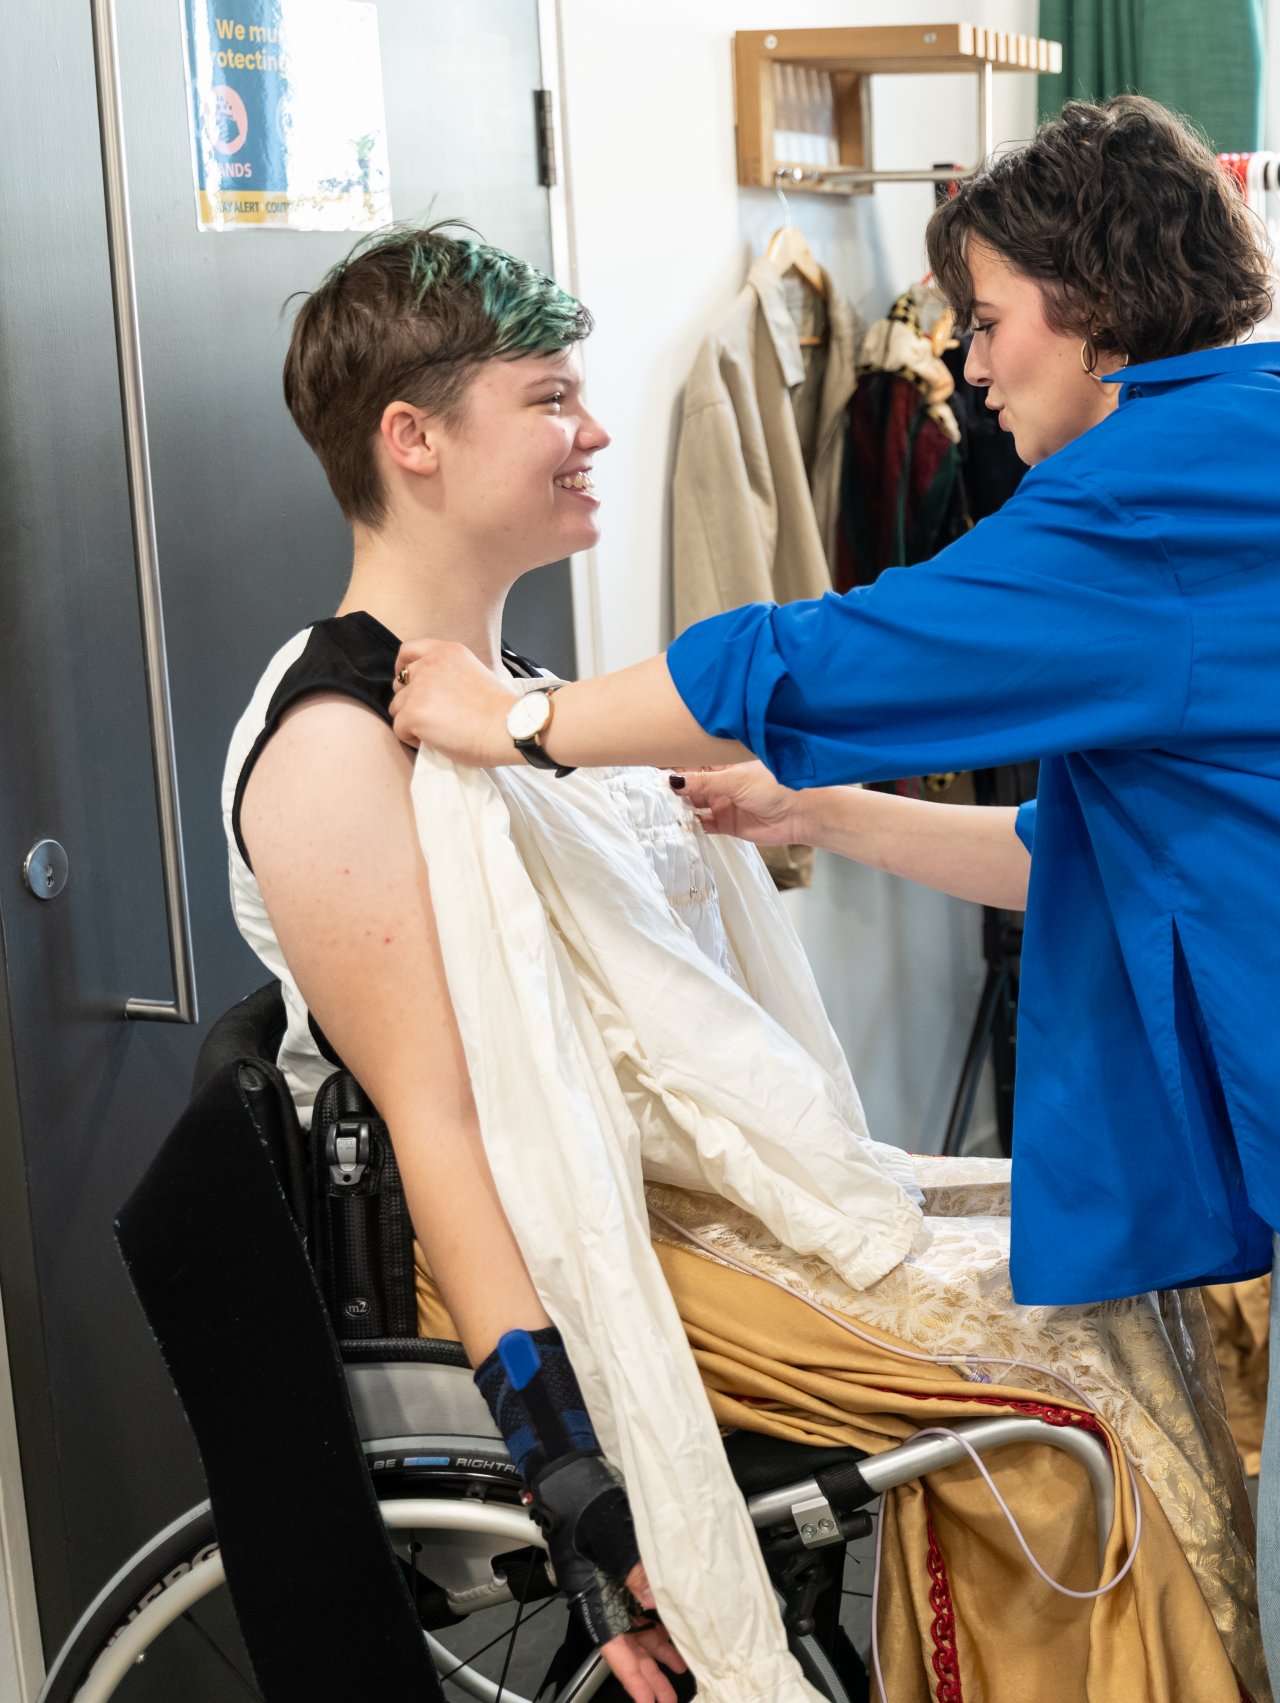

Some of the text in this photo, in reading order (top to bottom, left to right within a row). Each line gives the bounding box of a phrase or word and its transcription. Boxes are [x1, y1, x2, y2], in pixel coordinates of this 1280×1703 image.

[216, 19, 286, 44] We mu
[219, 162, 252, 178] ANDS
[234, 201, 259, 213] ALERT
[371, 1458, 397, 1470] BE
